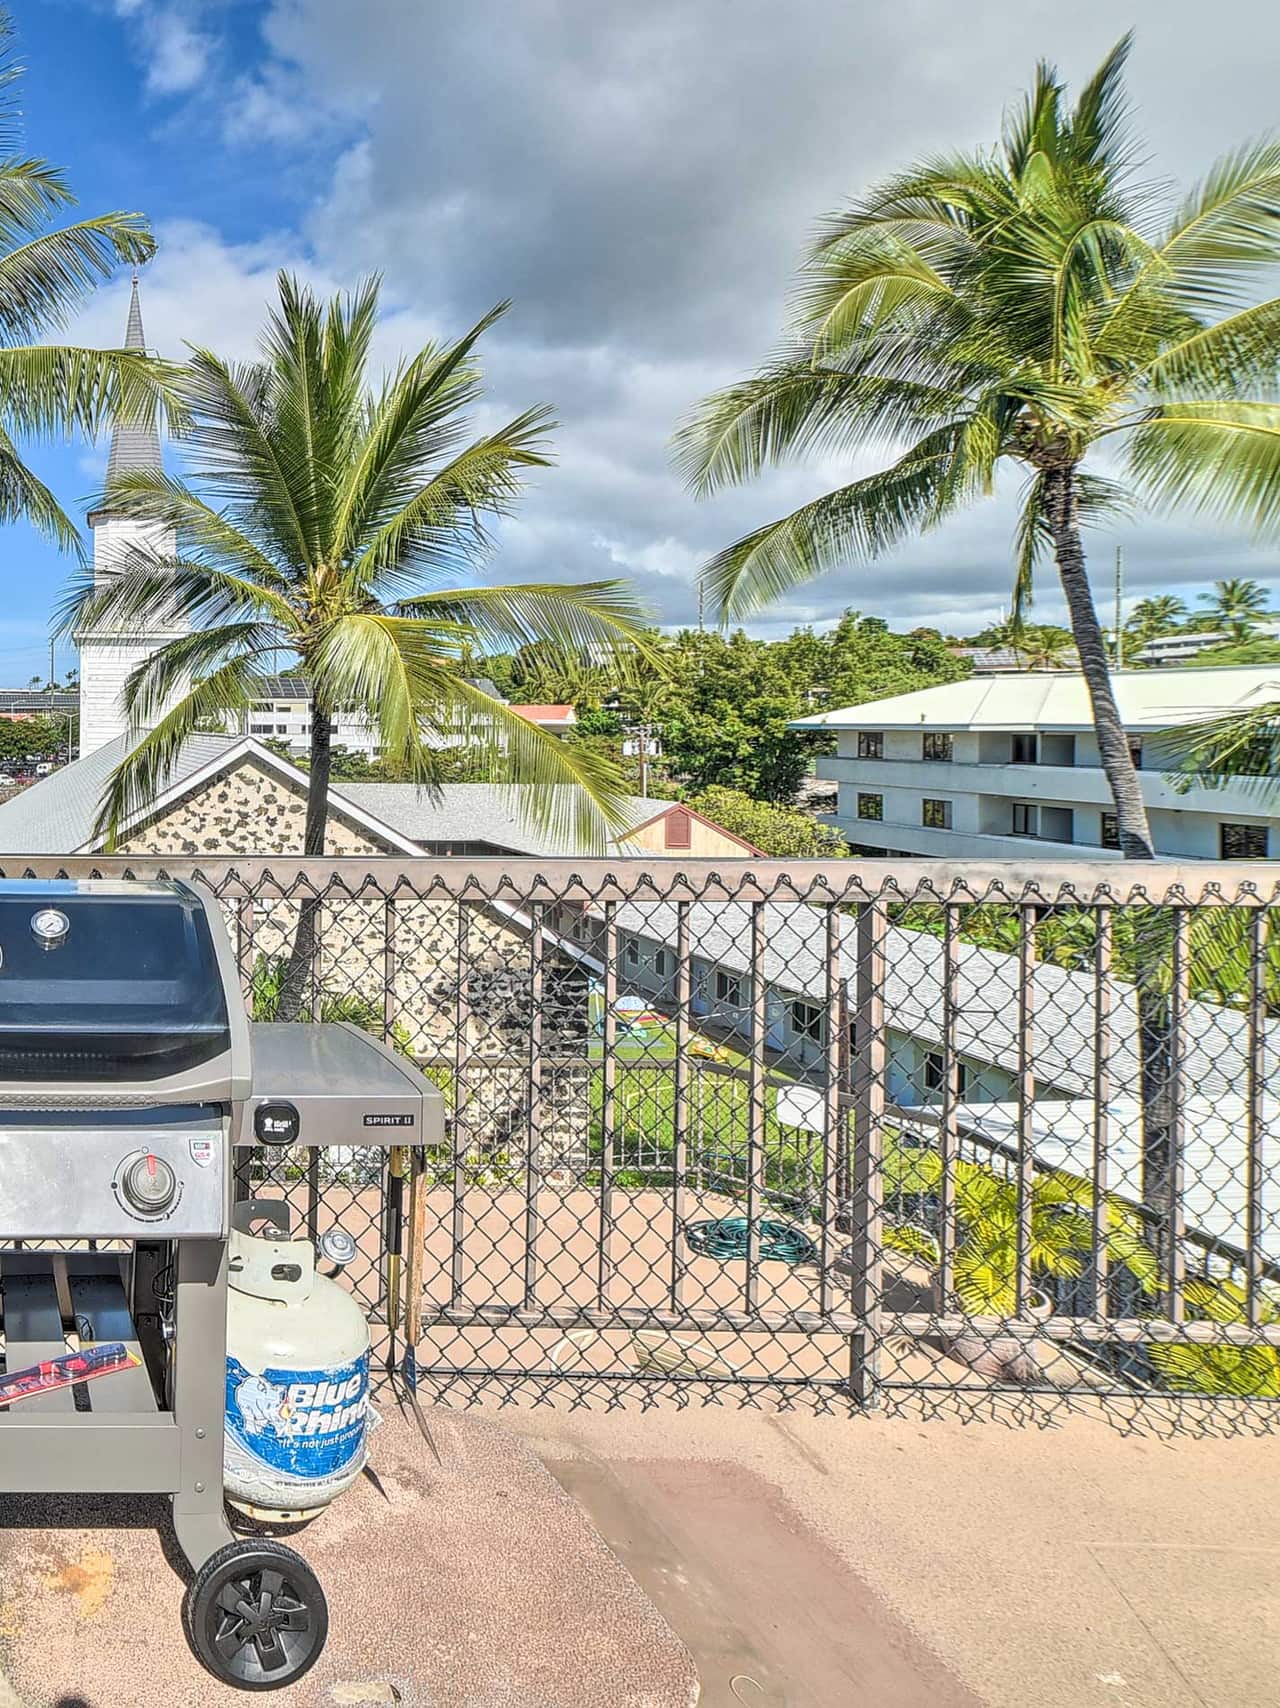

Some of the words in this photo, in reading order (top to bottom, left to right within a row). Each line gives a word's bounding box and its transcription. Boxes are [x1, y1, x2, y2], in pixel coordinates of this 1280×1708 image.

[366, 1116, 401, 1125] SPIRIT
[404, 1116, 412, 1125] II
[287, 1372, 361, 1408] Blue
